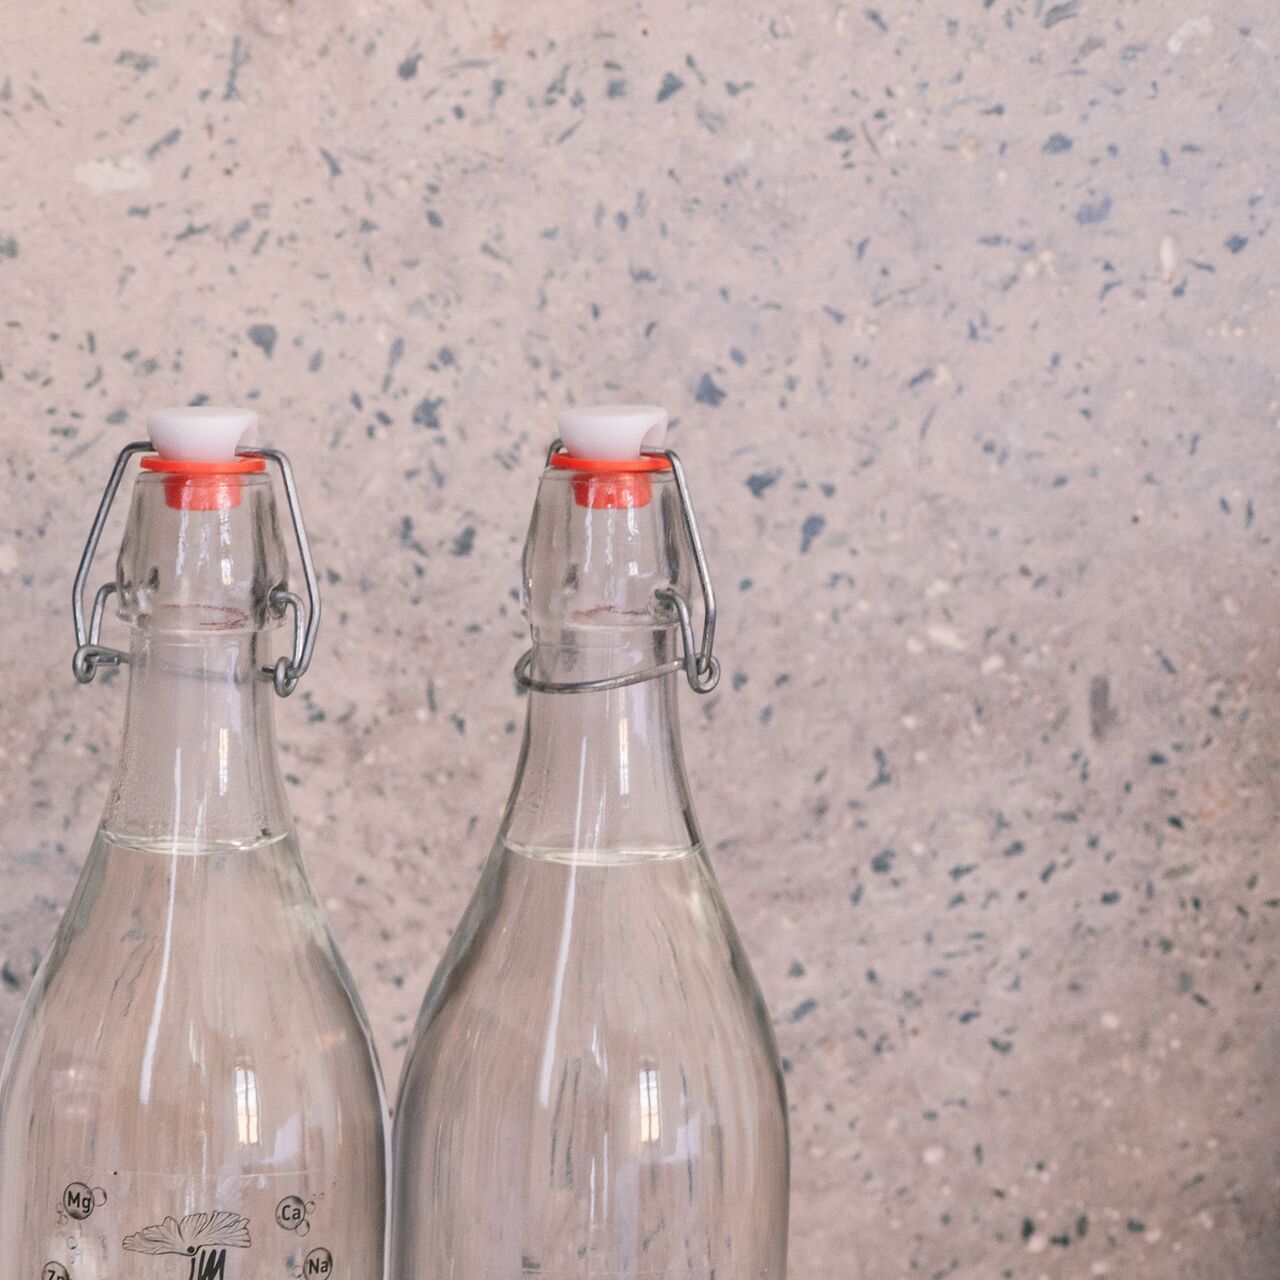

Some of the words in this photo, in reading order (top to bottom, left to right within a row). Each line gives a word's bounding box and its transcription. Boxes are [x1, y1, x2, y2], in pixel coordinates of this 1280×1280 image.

[67, 1190, 91, 1213] Mg
[281, 1205, 302, 1221] Ca
[308, 1257, 329, 1274] Na
